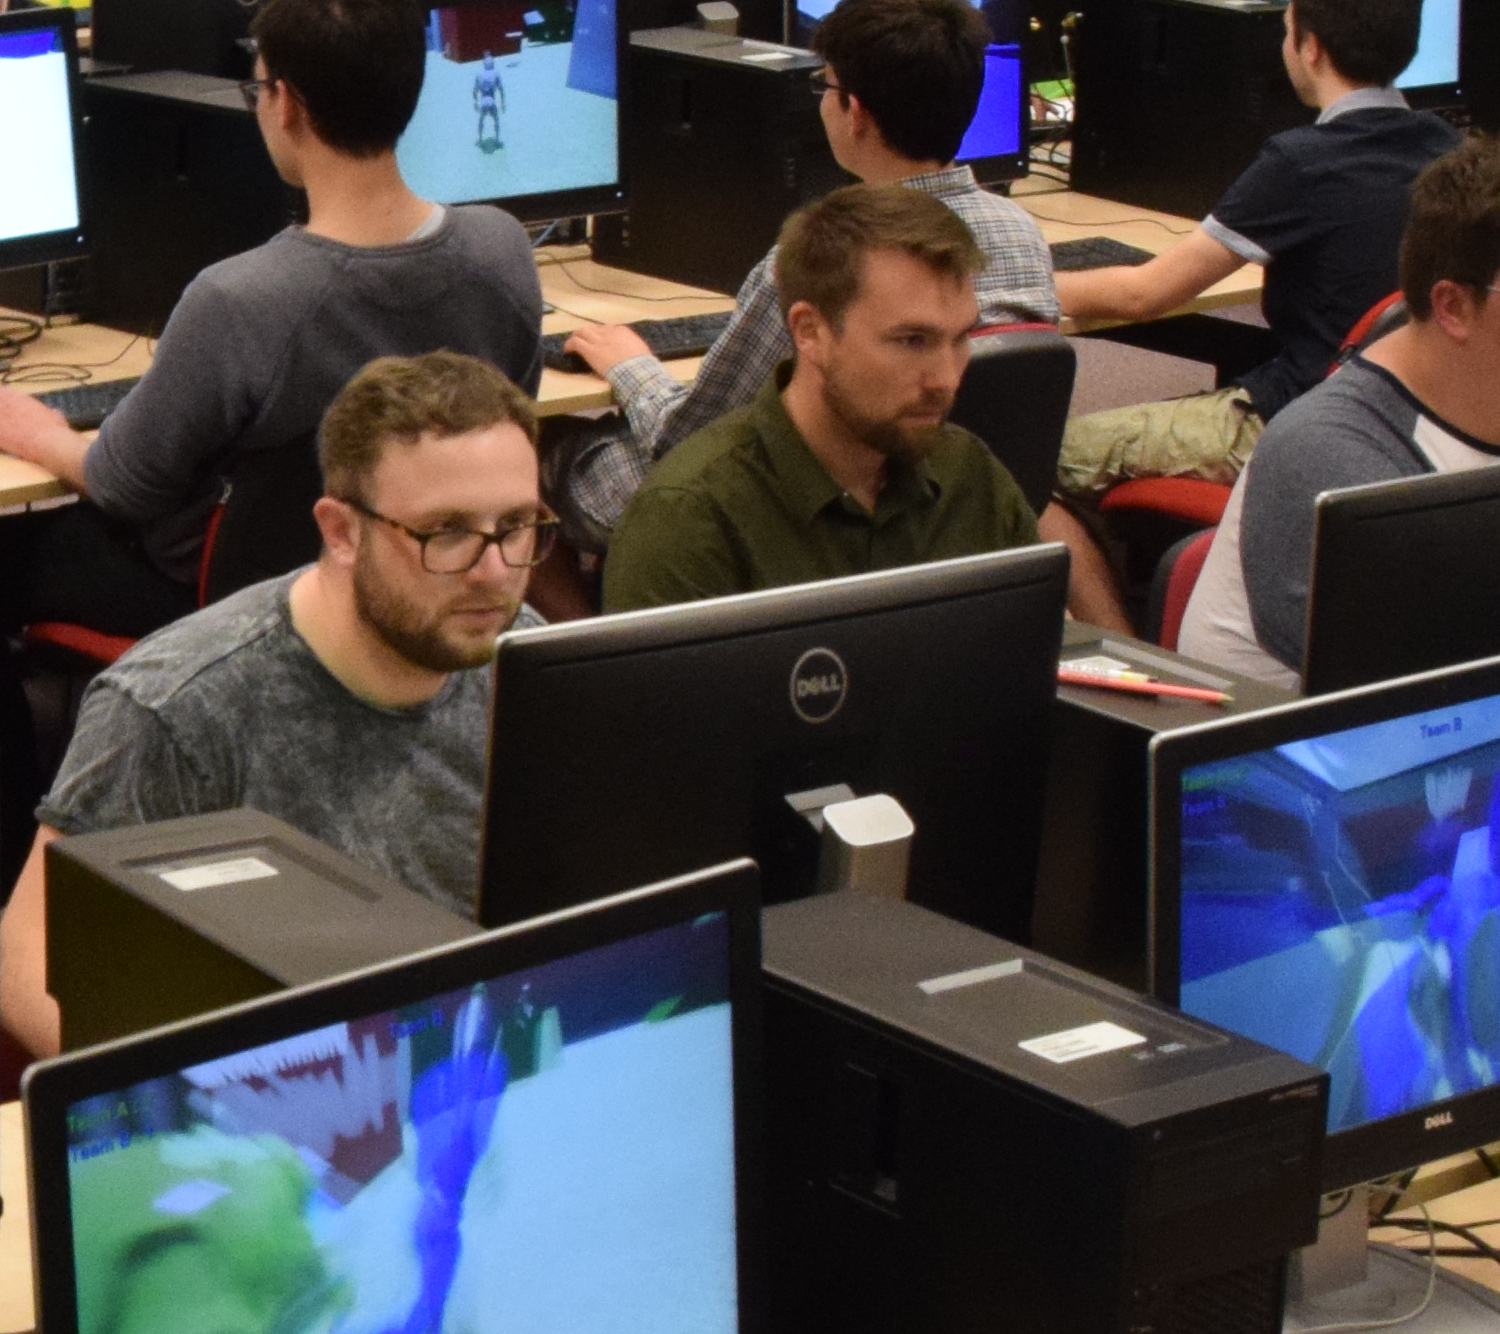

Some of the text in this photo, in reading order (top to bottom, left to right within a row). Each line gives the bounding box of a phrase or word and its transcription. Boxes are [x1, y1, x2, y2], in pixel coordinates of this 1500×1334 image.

[796, 673, 841, 697] DELL
[1420, 722, 1450, 738] Team
[1424, 1111, 1453, 1130] DELL
